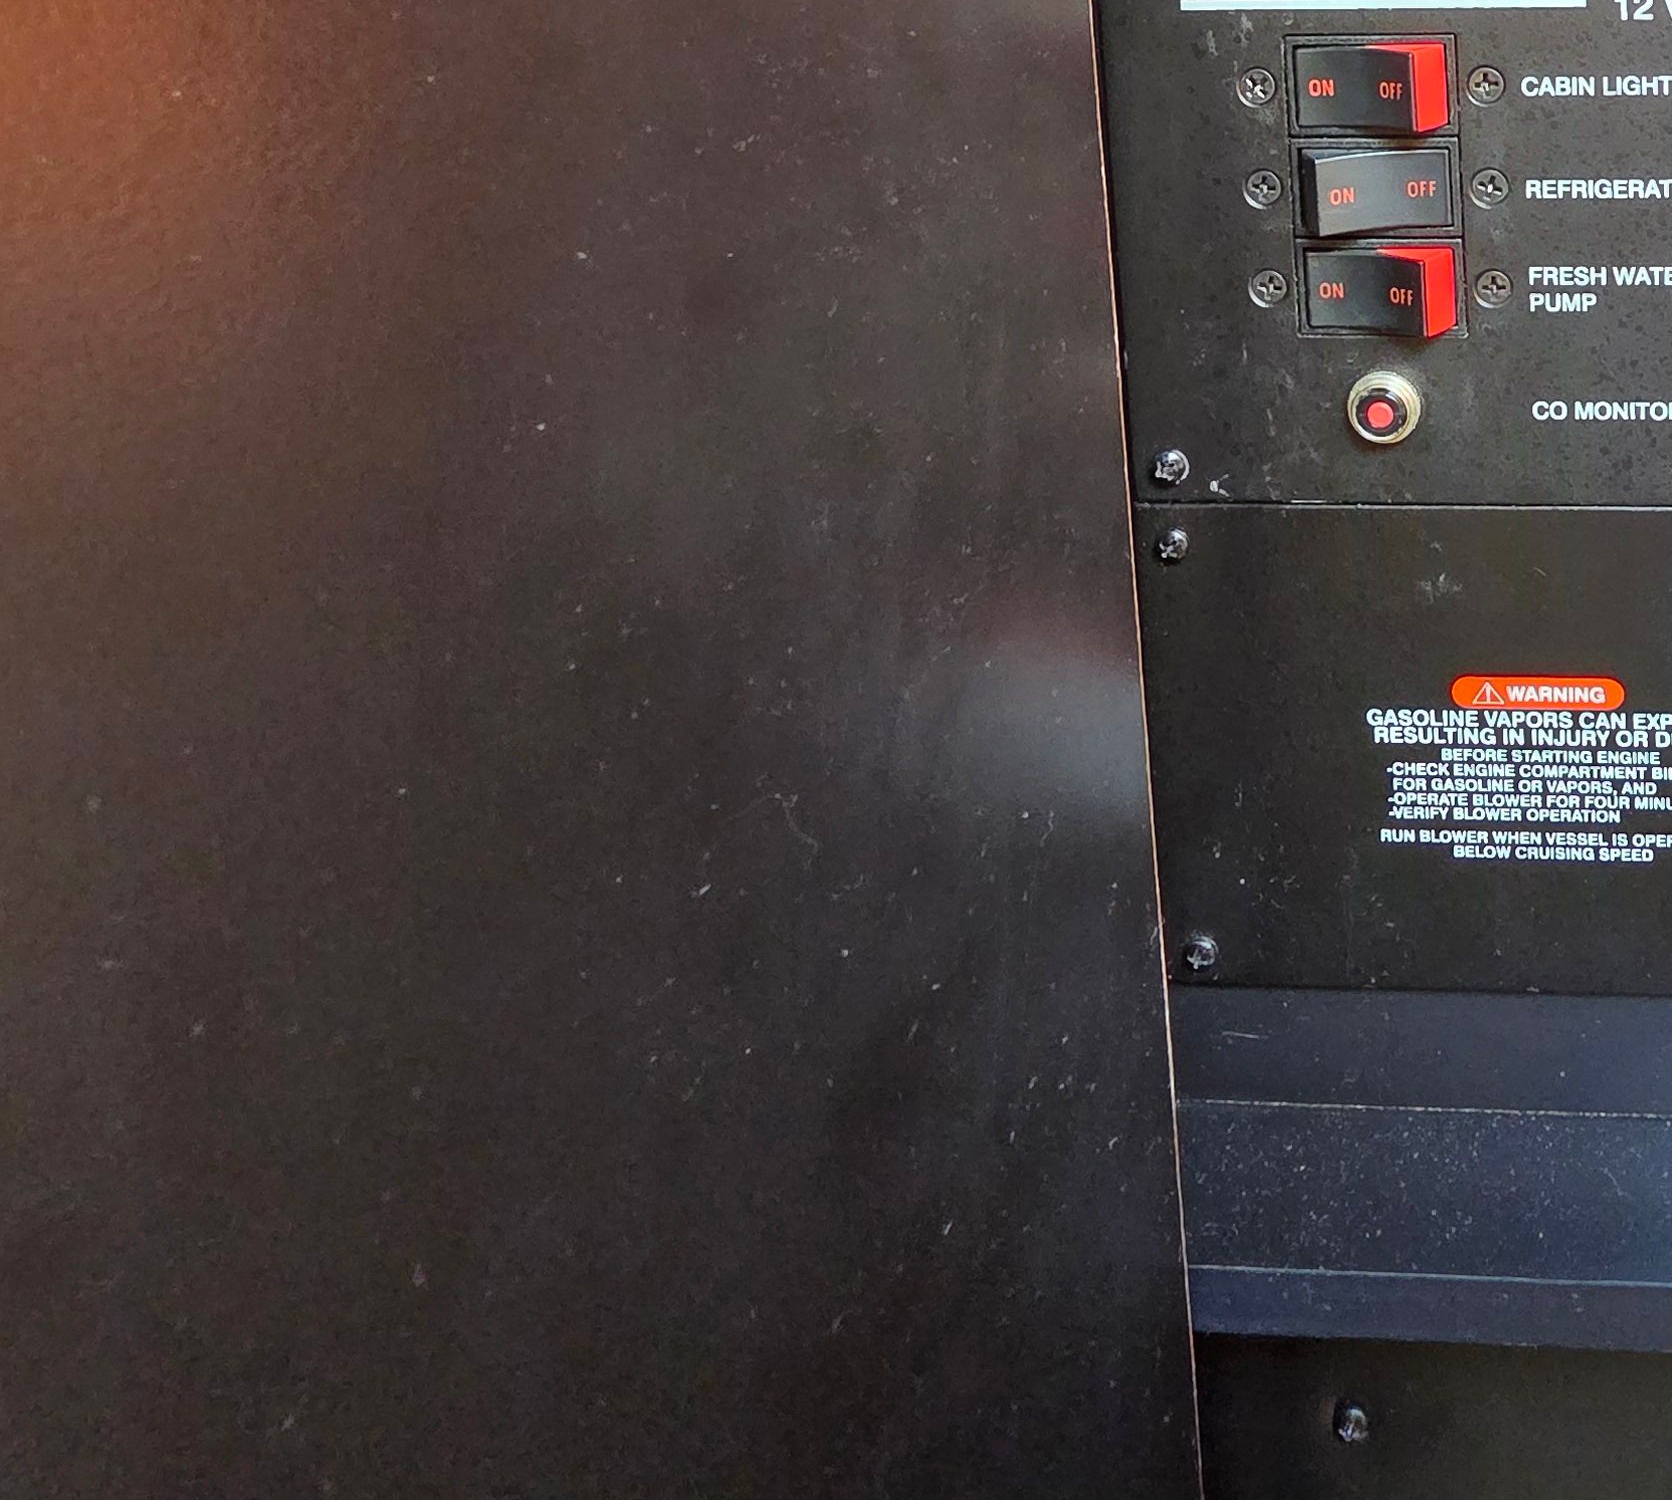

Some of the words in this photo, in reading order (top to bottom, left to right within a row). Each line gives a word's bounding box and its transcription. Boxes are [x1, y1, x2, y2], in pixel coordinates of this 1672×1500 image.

[1309, 80, 1334, 96] ON
[1380, 82, 1402, 99] OFF
[1521, 77, 1594, 96] CABIN
[1330, 188, 1354, 205] ON
[1408, 181, 1435, 197] OFF
[1529, 266, 1606, 286] FRESH
[1320, 283, 1343, 298] ON
[1390, 288, 1412, 305] OFF
[1530, 293, 1596, 312] PUMP
[1532, 401, 1567, 420] CO
[1504, 684, 1607, 706] WARNING
[1367, 709, 1479, 727] GASOLINE
[1484, 711, 1573, 729] VAPORS
[1579, 712, 1626, 730] CAN
[1374, 727, 1496, 745] RESULTING
[1503, 729, 1524, 745] IN
[1531, 729, 1610, 747] INJURY
[1616, 731, 1648, 747] OR
[1441, 748, 1507, 762] BEFORE
[1511, 750, 1592, 763] STARTING
[1597, 751, 1660, 764] ENGINE
[1454, 763, 1515, 776] ENGINE
[1519, 765, 1647, 779] COMPARTMENT
[1393, 778, 1426, 791] FOR
[1431, 778, 1514, 792] GASOLINE
[1518, 780, 1543, 793] OR
[1547, 780, 1618, 798] VAPORS,
[1622, 782, 1657, 795] AND
[1473, 794, 1542, 807] BLOWER
[1547, 795, 1580, 808] FOR
[1585, 794, 1630, 809] FOUR
[1453, 807, 1521, 821] BLOWER
[1526, 808, 1620, 823] OPERATION
[1381, 829, 1415, 842] RUN
[1420, 830, 1488, 844] BLOWER
[1492, 831, 1541, 845] WHEN
[1546, 833, 1608, 846] VESSEL
[1612, 834, 1628, 846] IS
[1454, 845, 1511, 858] BELOW
[1515, 847, 1594, 860] CRUISING
[1599, 848, 1653, 861] SPEED
